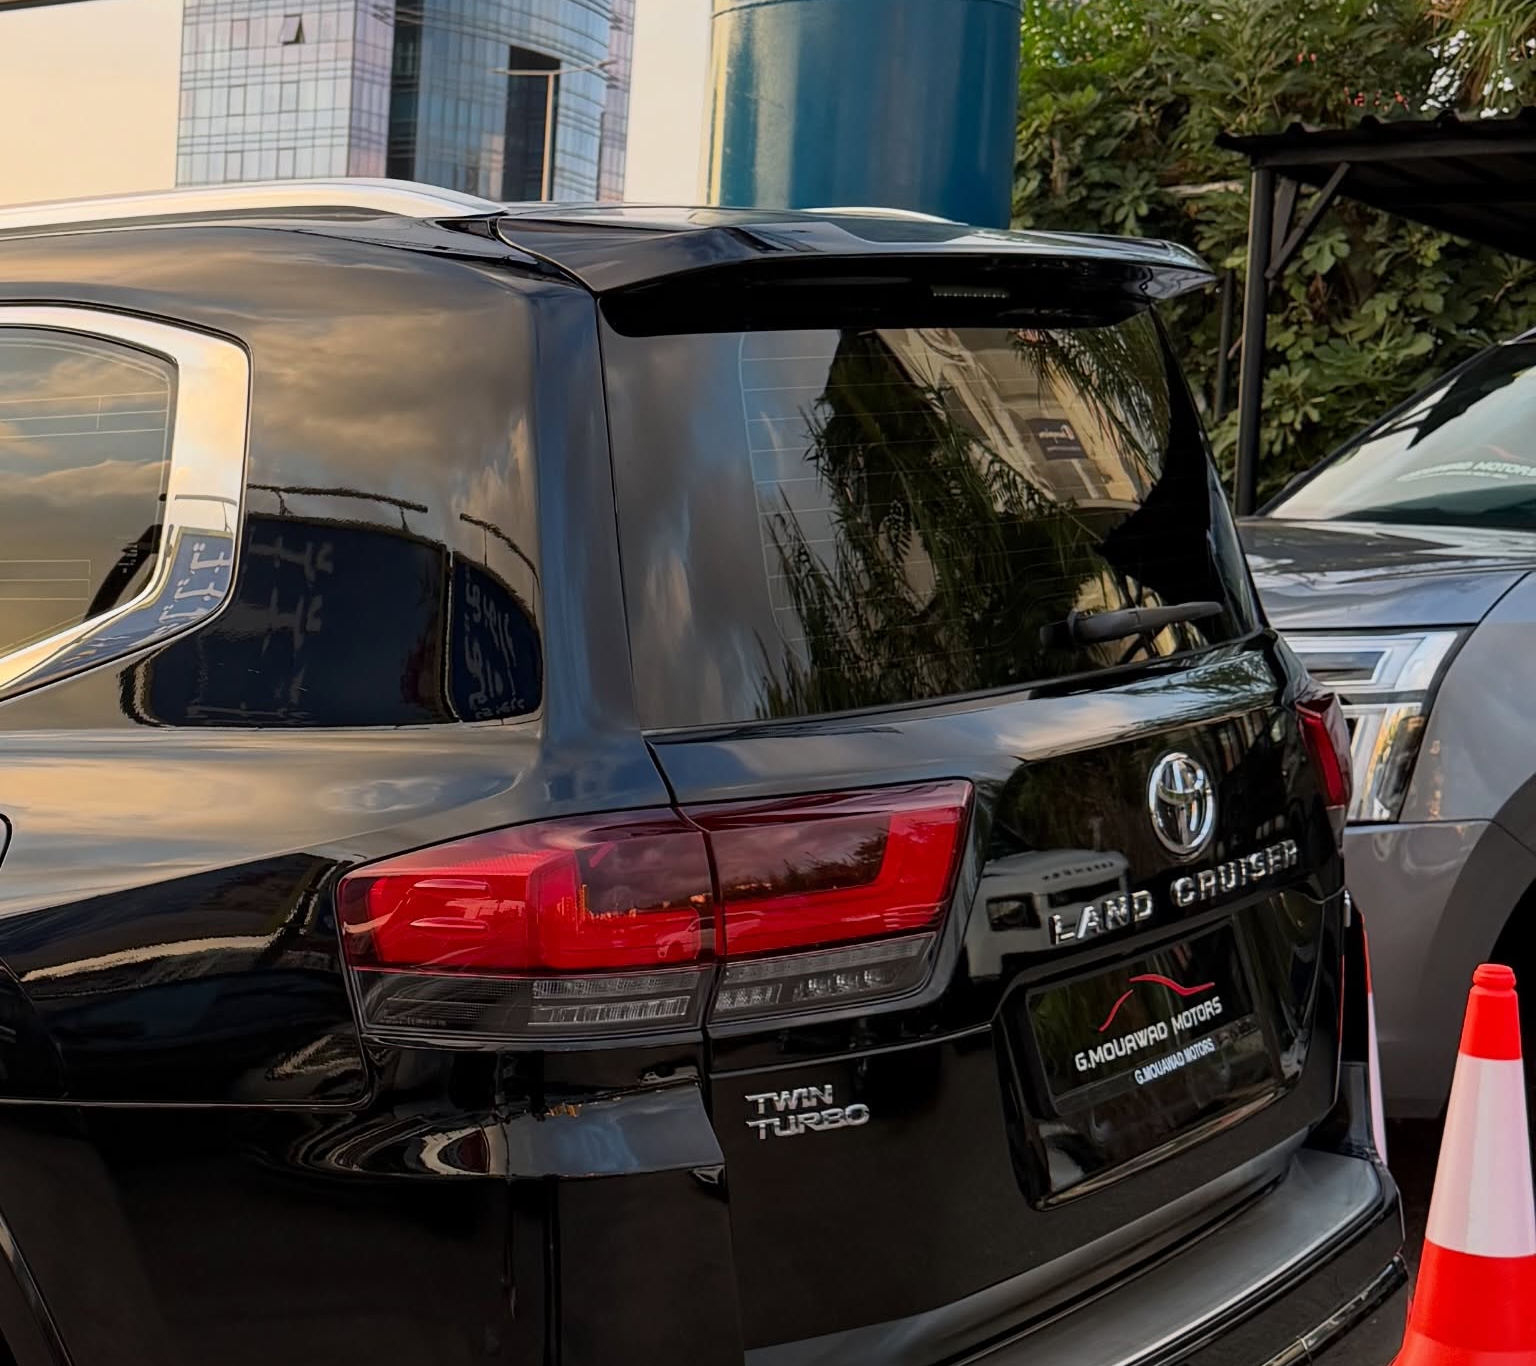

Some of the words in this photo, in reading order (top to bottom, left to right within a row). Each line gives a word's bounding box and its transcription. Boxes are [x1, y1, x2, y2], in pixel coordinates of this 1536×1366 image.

[1049, 889, 1153, 945] LAND
[1170, 839, 1298, 907] CRUISER
[1075, 1021, 1168, 1072] G.MOUAWAD
[1171, 996, 1222, 1035] MOTORS
[1183, 1037, 1216, 1063] MOTORS
[745, 1084, 832, 1114] TWIN
[745, 1103, 870, 1140] TURBO
